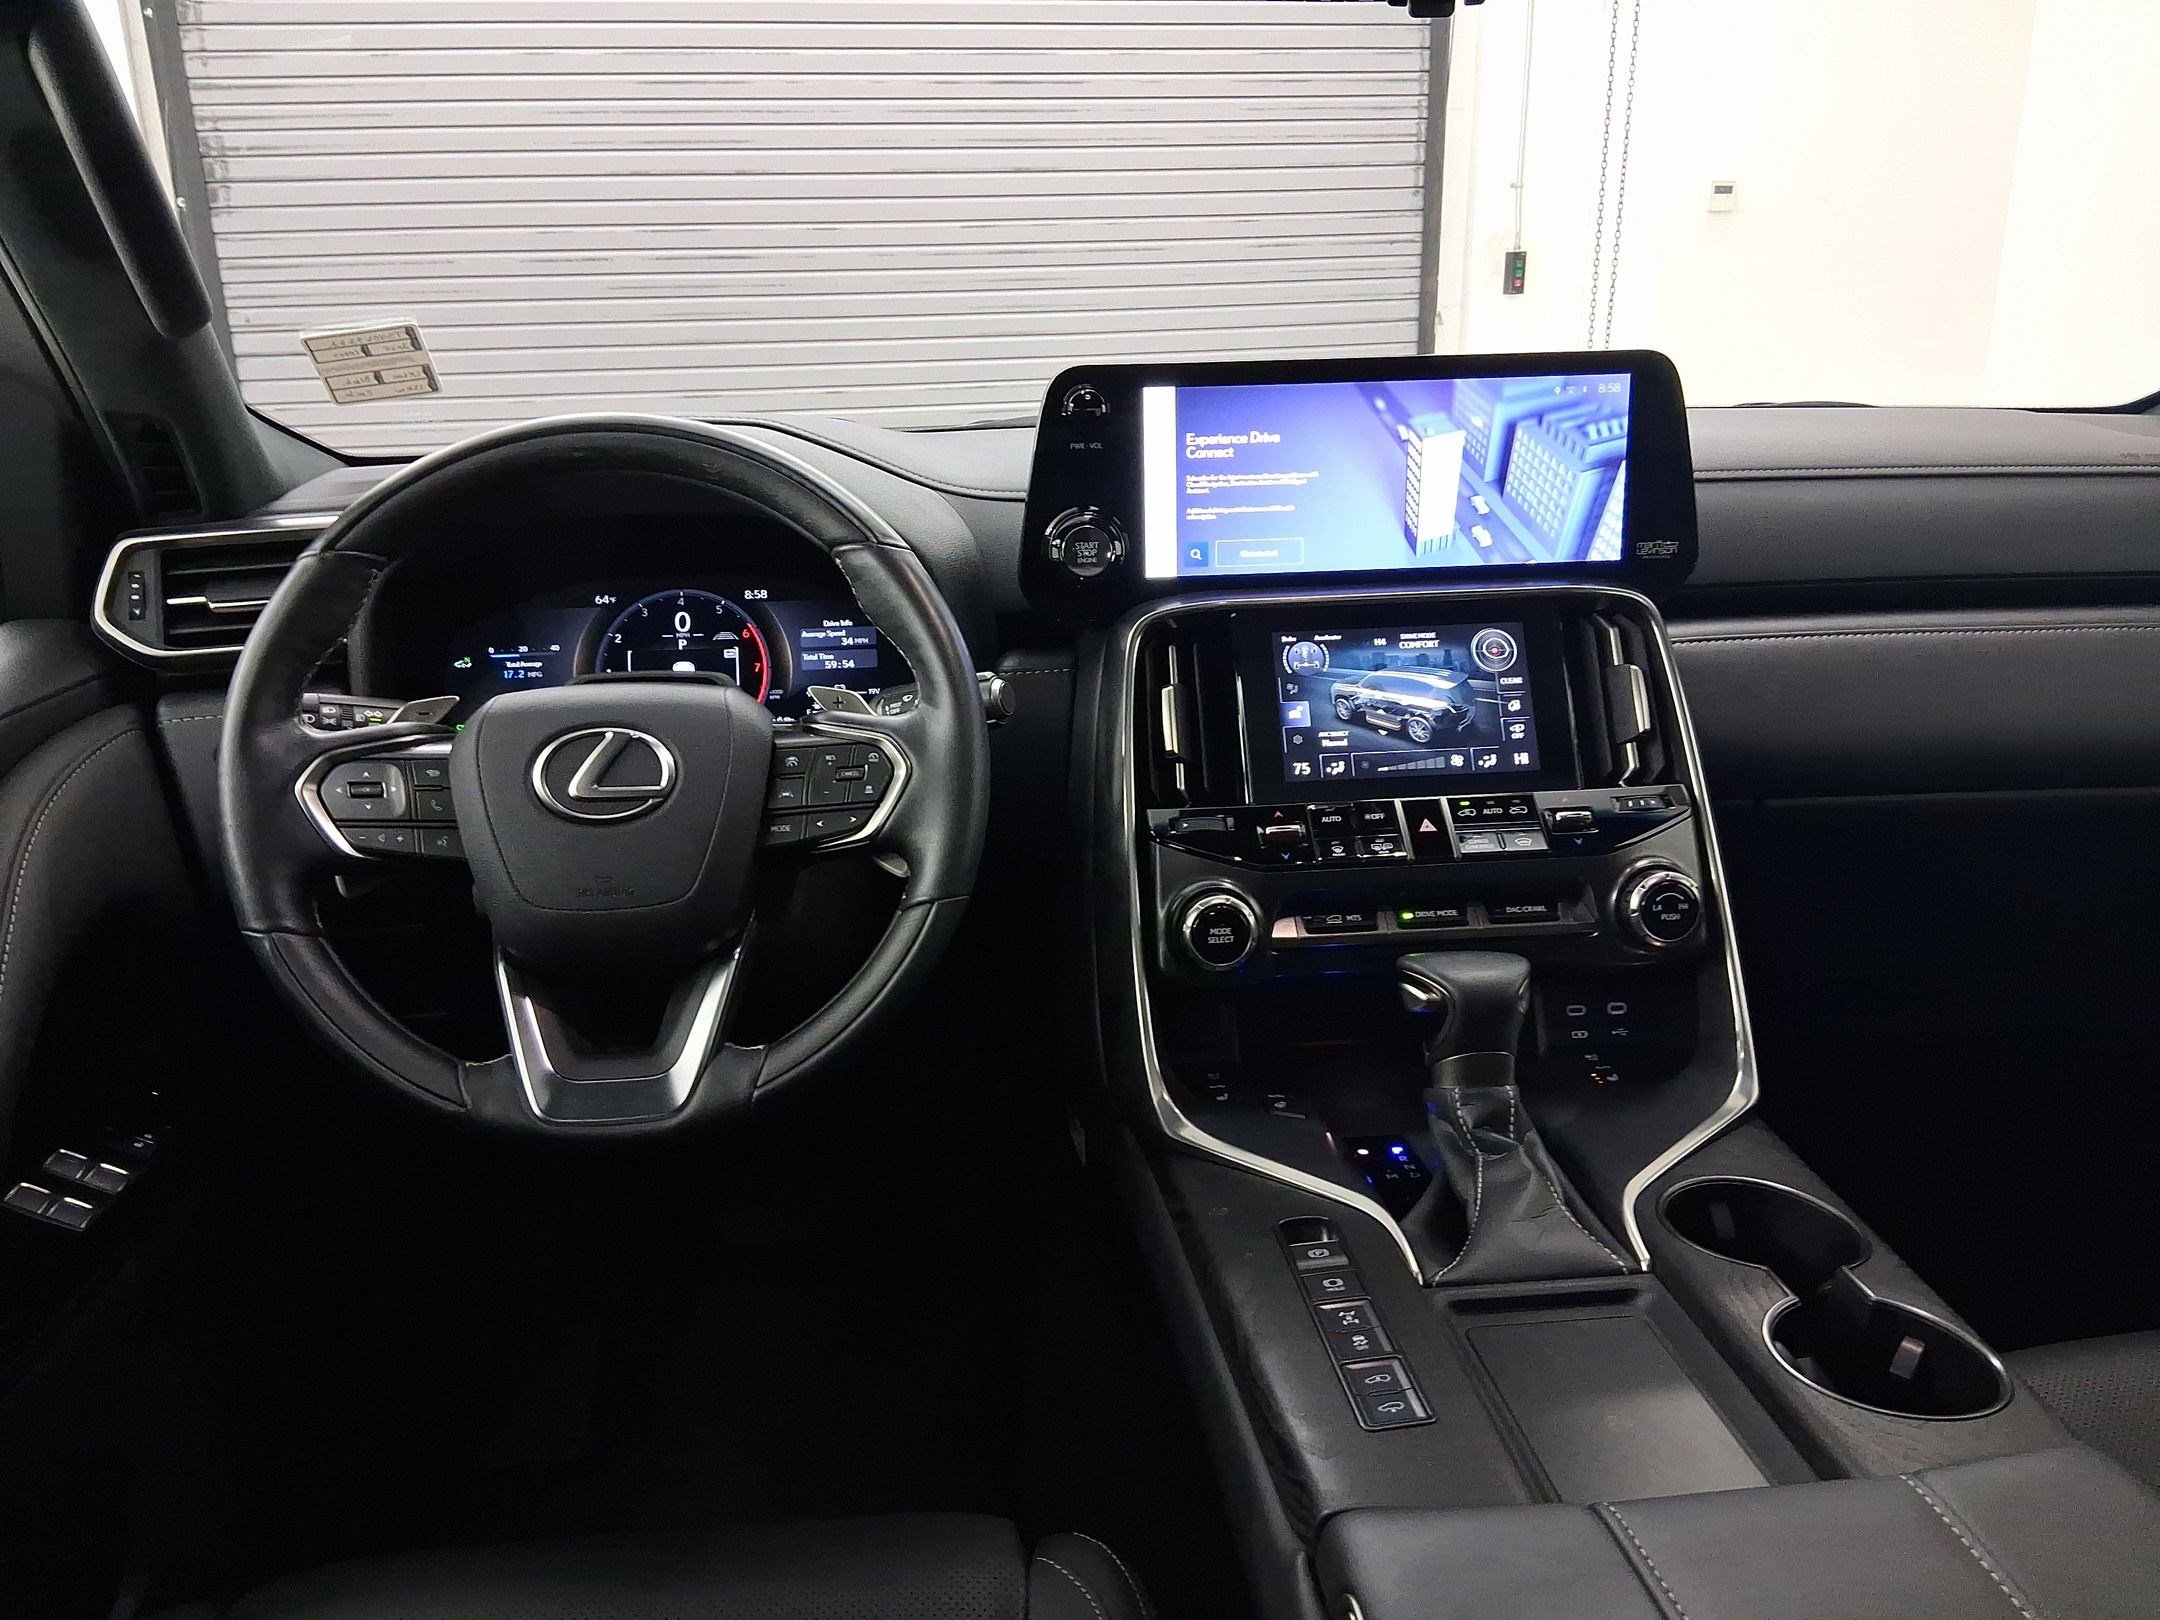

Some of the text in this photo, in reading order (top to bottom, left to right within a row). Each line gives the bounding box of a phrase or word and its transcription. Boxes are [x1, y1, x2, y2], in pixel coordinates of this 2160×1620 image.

[1598, 383, 1622, 393] 8:58
[1185, 431, 1281, 447] Experience Drive
[1185, 446, 1235, 459] Connect
[1074, 541, 1100, 550] START
[1076, 549, 1098, 557] STOP
[744, 590, 768, 600] 8:58
[677, 598, 685, 606] 4
[642, 608, 649, 617] 3
[716, 605, 723, 615] 5
[674, 611, 691, 633] 0
[823, 620, 840, 628] Drive
[742, 629, 750, 638] 6
[826, 629, 846, 638] Speed
[614, 634, 622, 643] 2
[841, 637, 854, 646] 34
[518, 645, 529, 653] 20
[550, 644, 561, 652] 40
[678, 639, 687, 650] P
[1399, 640, 1440, 649] COMFORT
[754, 663, 761, 673] 7
[825, 660, 855, 669] 59:54
[504, 669, 525, 679] 17.2
[1500, 676, 1523, 685] CLEAR
[1513, 752, 1530, 765] HI
[1293, 762, 1312, 776] 75
[1321, 815, 1342, 823] AUTO
[770, 824, 792, 833] MODE
[1437, 909, 1458, 917] MODE
[1209, 927, 1232, 935] MODE
[1207, 936, 1234, 944] SELECT
